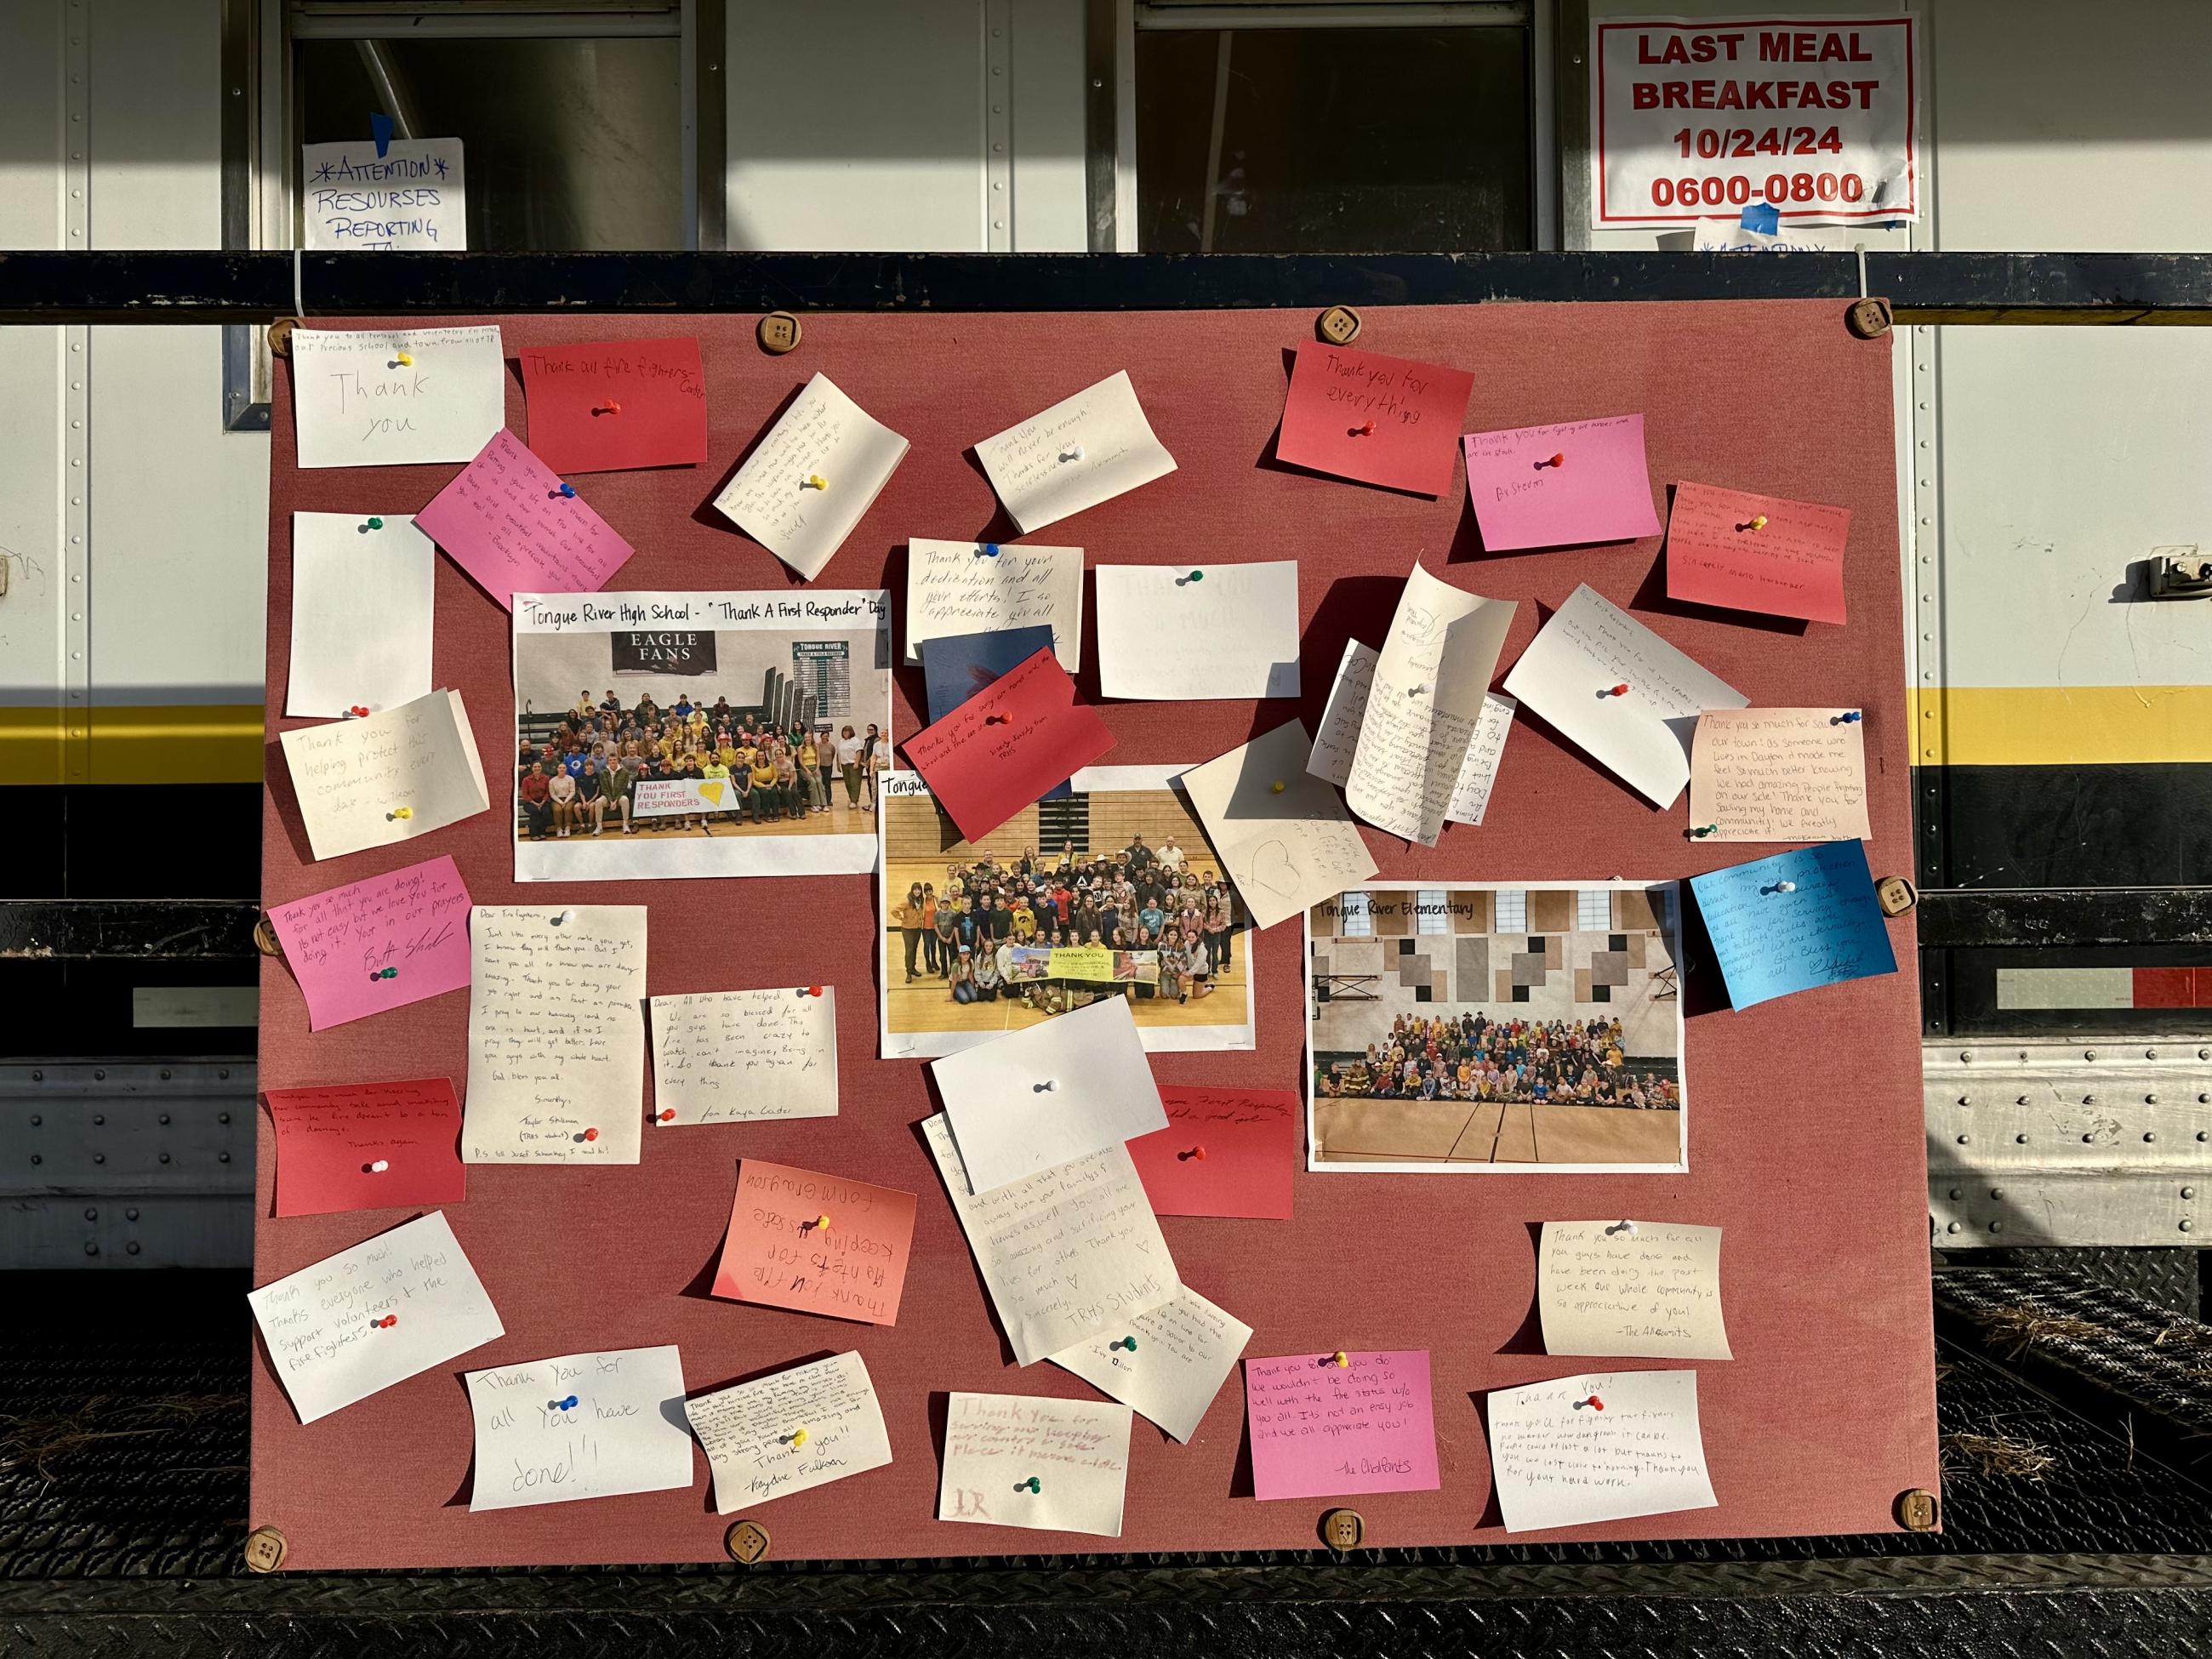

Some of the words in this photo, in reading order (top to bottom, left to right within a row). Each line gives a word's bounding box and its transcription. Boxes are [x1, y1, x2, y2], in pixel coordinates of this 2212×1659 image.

[1639, 34, 1744, 65] LAST
[1759, 32, 1873, 62] MEAL
[1632, 80, 1879, 110] BREAKFAST
[1673, 125, 1843, 158] 10/24/24
[1651, 173, 1864, 207] 0600-0800
[312, 189, 441, 214] RESOURSES
[326, 218, 437, 243] REPORTING
[527, 356, 574, 375] Thank
[581, 360, 597, 374] all
[603, 356, 630, 379] fire
[1327, 354, 1365, 378] Thank
[1367, 370, 1395, 388] you
[1402, 369, 1429, 395] for
[330, 369, 430, 414] Thank
[362, 417, 417, 442] you
[1471, 432, 1509, 448] Thank
[925, 550, 961, 566] Thank
[964, 556, 988, 573] you
[995, 553, 1017, 569] for
[1022, 555, 1053, 573] your
[921, 570, 995, 587] dedication
[1001, 568, 1032, 585] and
[1032, 567, 1053, 585] all
[920, 591, 951, 613] your
[1015, 589, 1035, 604] I
[1037, 592, 1051, 601] so
[522, 601, 577, 630] Tongue
[583, 602, 616, 620] River
[620, 602, 646, 626] High
[651, 602, 689, 620] School
[764, 603, 774, 619] A
[778, 602, 801, 619] First
[869, 601, 886, 620] Day
[927, 607, 1000, 620] appreciate
[1003, 609, 1032, 627] you
[1033, 603, 1055, 618] all
[631, 633, 698, 647] EAGLE
[640, 647, 691, 661] FANS
[1703, 715, 1730, 730] Thank
[1736, 721, 1748, 733] you
[1752, 721, 1759, 729] so
[1764, 717, 1794, 729] much
[1796, 716, 1810, 729] for
[295, 731, 344, 752] Thank
[361, 728, 392, 745] you
[1712, 738, 1729, 746] our
[1782, 738, 1822, 748] someone
[1827, 737, 1846, 745] who
[305, 758, 347, 778] helping
[357, 743, 399, 768] protect
[1752, 750, 1784, 765] Dayton
[1798, 750, 1825, 760] made
[316, 767, 400, 795] community
[1713, 764, 1731, 775] feel
[1782, 766, 1805, 775] better
[1811, 765, 1853, 777] knowing
[637, 791, 658, 800] YOU
[660, 790, 687, 799] FIRST
[640, 783, 670, 791] THANK
[881, 777, 929, 796] Tongue
[1735, 778, 1754, 788] had
[1758, 781, 1799, 795] amazing
[637, 799, 700, 810] RESPONDERS
[1778, 791, 1812, 802] Thank
[1818, 795, 1839, 806] you
[1844, 796, 1859, 805] for
[1750, 806, 1765, 817] my
[1770, 803, 1793, 815] home
[1800, 805, 1819, 817] and
[1719, 863, 1784, 885] community
[283, 909, 305, 923] Thank
[309, 904, 321, 916] you
[293, 924, 307, 933] for
[316, 911, 328, 924] all
[333, 901, 355, 917] that
[359, 896, 372, 911] you
[376, 888, 391, 898] are
[394, 872, 425, 898] doing!
[311, 931, 324, 944] not
[328, 921, 351, 936] easy
[353, 912, 368, 923] but
[388, 897, 406, 909] love
[408, 890, 427, 906] you
[431, 882, 448, 893] for
[1315, 900, 1360, 922] Tongue
[1367, 900, 1398, 915] River
[1400, 900, 1474, 920] Elementary
[303, 949, 328, 966] doing
[386, 918, 396, 927] in
[406, 908, 424, 921] our
[431, 892, 465, 916] prayers
[722, 993, 742, 1001] have
[744, 1007, 772, 1017] blessed
[687, 1023, 708, 1033] guys
[721, 1021, 741, 1029] have
[763, 1031, 793, 1040] crazy
[664, 1047, 687, 1057] watch
[1554, 1230, 1585, 1243] Thank
[1593, 1233, 1607, 1245] you
[1606, 1250, 1631, 1260] have
[314, 1274, 334, 1291] you
[342, 1263, 359, 1275] so
[1550, 1264, 1571, 1275] have
[1579, 1266, 1606, 1275] been
[268, 1309, 308, 1328] Thanks
[321, 1280, 374, 1310] everyone
[381, 1268, 403, 1285] who
[411, 1252, 447, 1274] helped
[1064, 1302, 1104, 1326] TRHS
[1106, 1273, 1162, 1311] Students
[1656, 1285, 1702, 1300] community
[279, 1327, 325, 1353] support
[333, 1294, 398, 1329] volunteers
[423, 1276, 448, 1292] the
[476, 1371, 536, 1389] Thank
[596, 1355, 624, 1376] for
[1252, 1366, 1280, 1377] Thank
[1285, 1364, 1301, 1375] you
[1348, 1373, 1378, 1386] doing
[957, 1397, 1023, 1420] Thank
[1072, 1416, 1099, 1425] for
[1252, 1397, 1273, 1405] well
[1369, 1403, 1392, 1413] easy
[491, 1405, 516, 1429] all
[592, 1397, 640, 1419] have
[512, 1433, 599, 1492] done!!!
[753, 1445, 801, 1469] Thank
